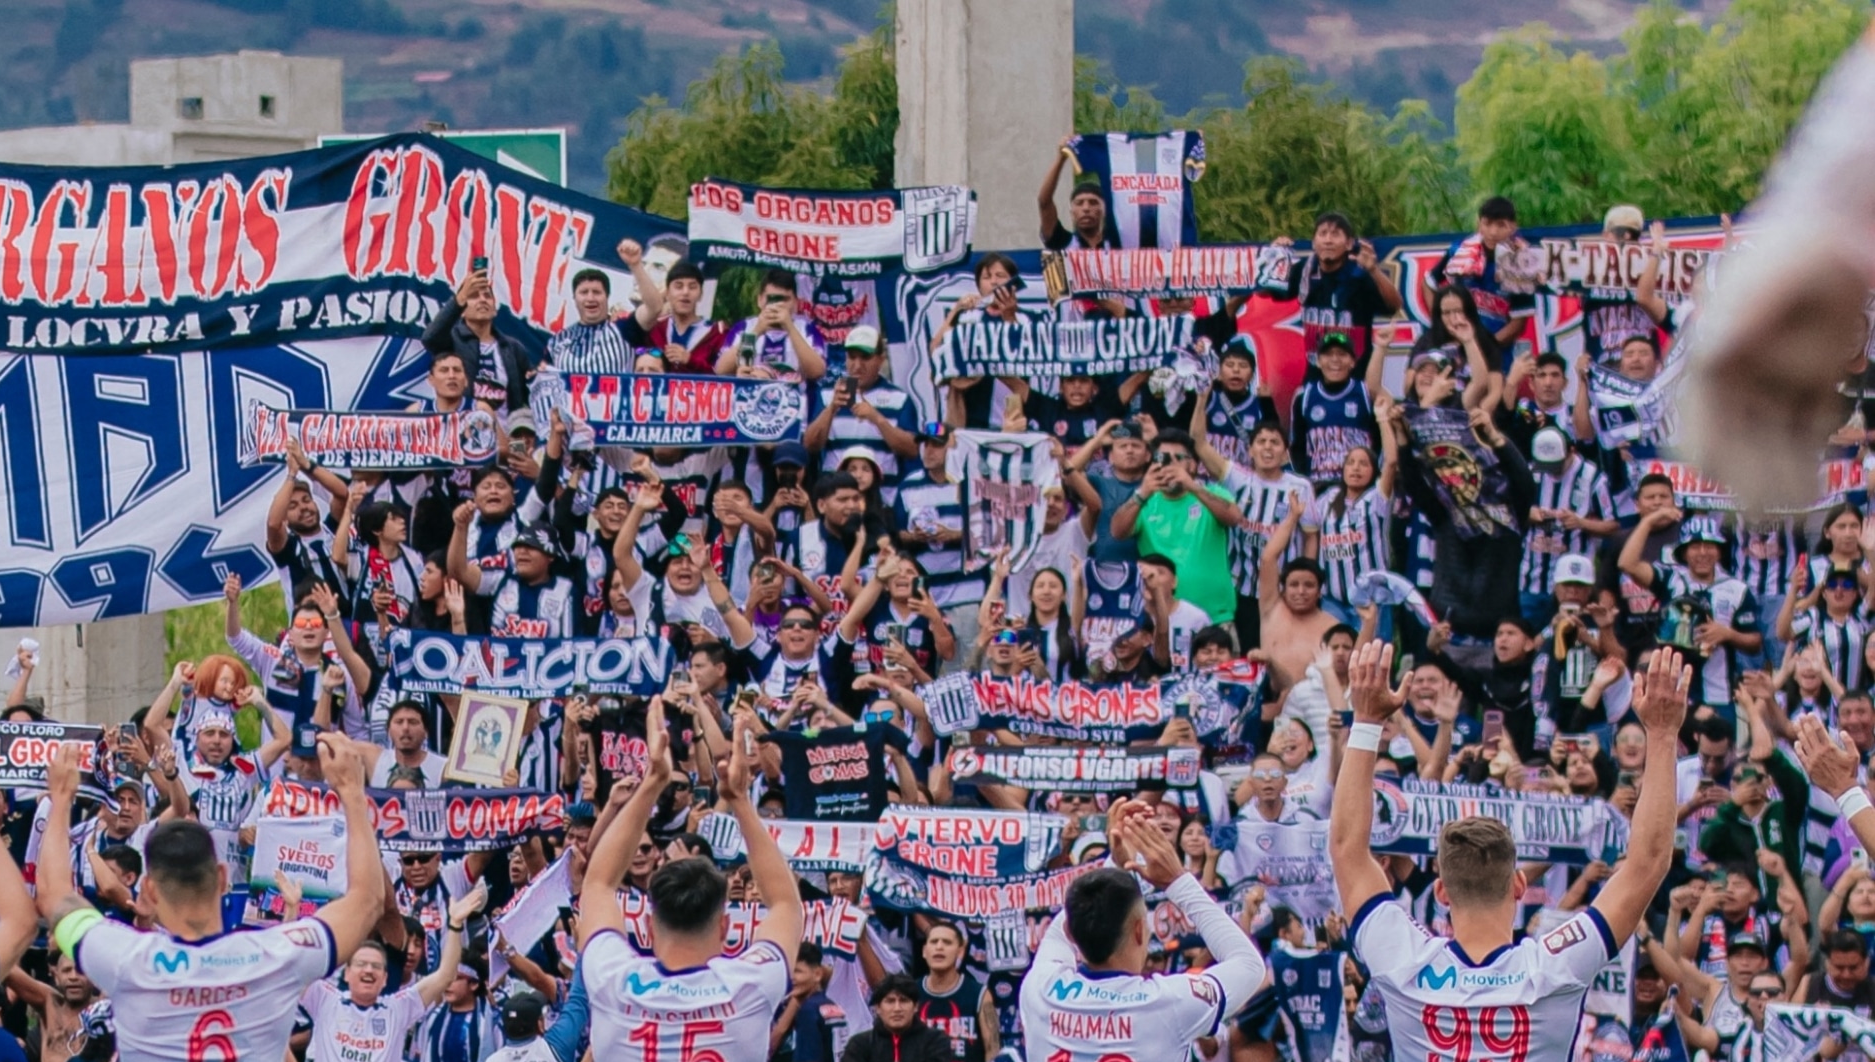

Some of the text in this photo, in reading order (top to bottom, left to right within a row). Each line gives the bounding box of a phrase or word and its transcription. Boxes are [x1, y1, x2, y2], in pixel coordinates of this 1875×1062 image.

[1111, 174, 1183, 192] ENCALADA
[691, 182, 895, 225] LOS ORGANOS
[342, 143, 595, 333] GRONE
[745, 225, 841, 261] GRONE
[7, 312, 204, 349] LOCVRA
[228, 304, 259, 336] Y
[606, 425, 702, 443] CAJAMARCA
[389, 630, 670, 690] COALICION
[974, 673, 1161, 728] NENAS GRONES
[21, 723, 65, 736] FLORO
[1009, 720, 1088, 742] COMANDO
[983, 756, 1165, 781] ALFONSO VGARTE
[448, 792, 565, 840] COMAS
[299, 839, 319, 851] LOS
[277, 846, 334, 870] SVELTOS
[898, 842, 1000, 877] GRONE
[277, 861, 329, 881] ARGENTINA
[928, 874, 1001, 915] ALIADOS
[1462, 970, 1527, 989] Movistar
[1087, 986, 1150, 1003] Movistar
[1050, 1010, 1133, 1042] HUAMÁN
[335, 1030, 385, 1050] apuesta
[341, 1046, 373, 1062] total
